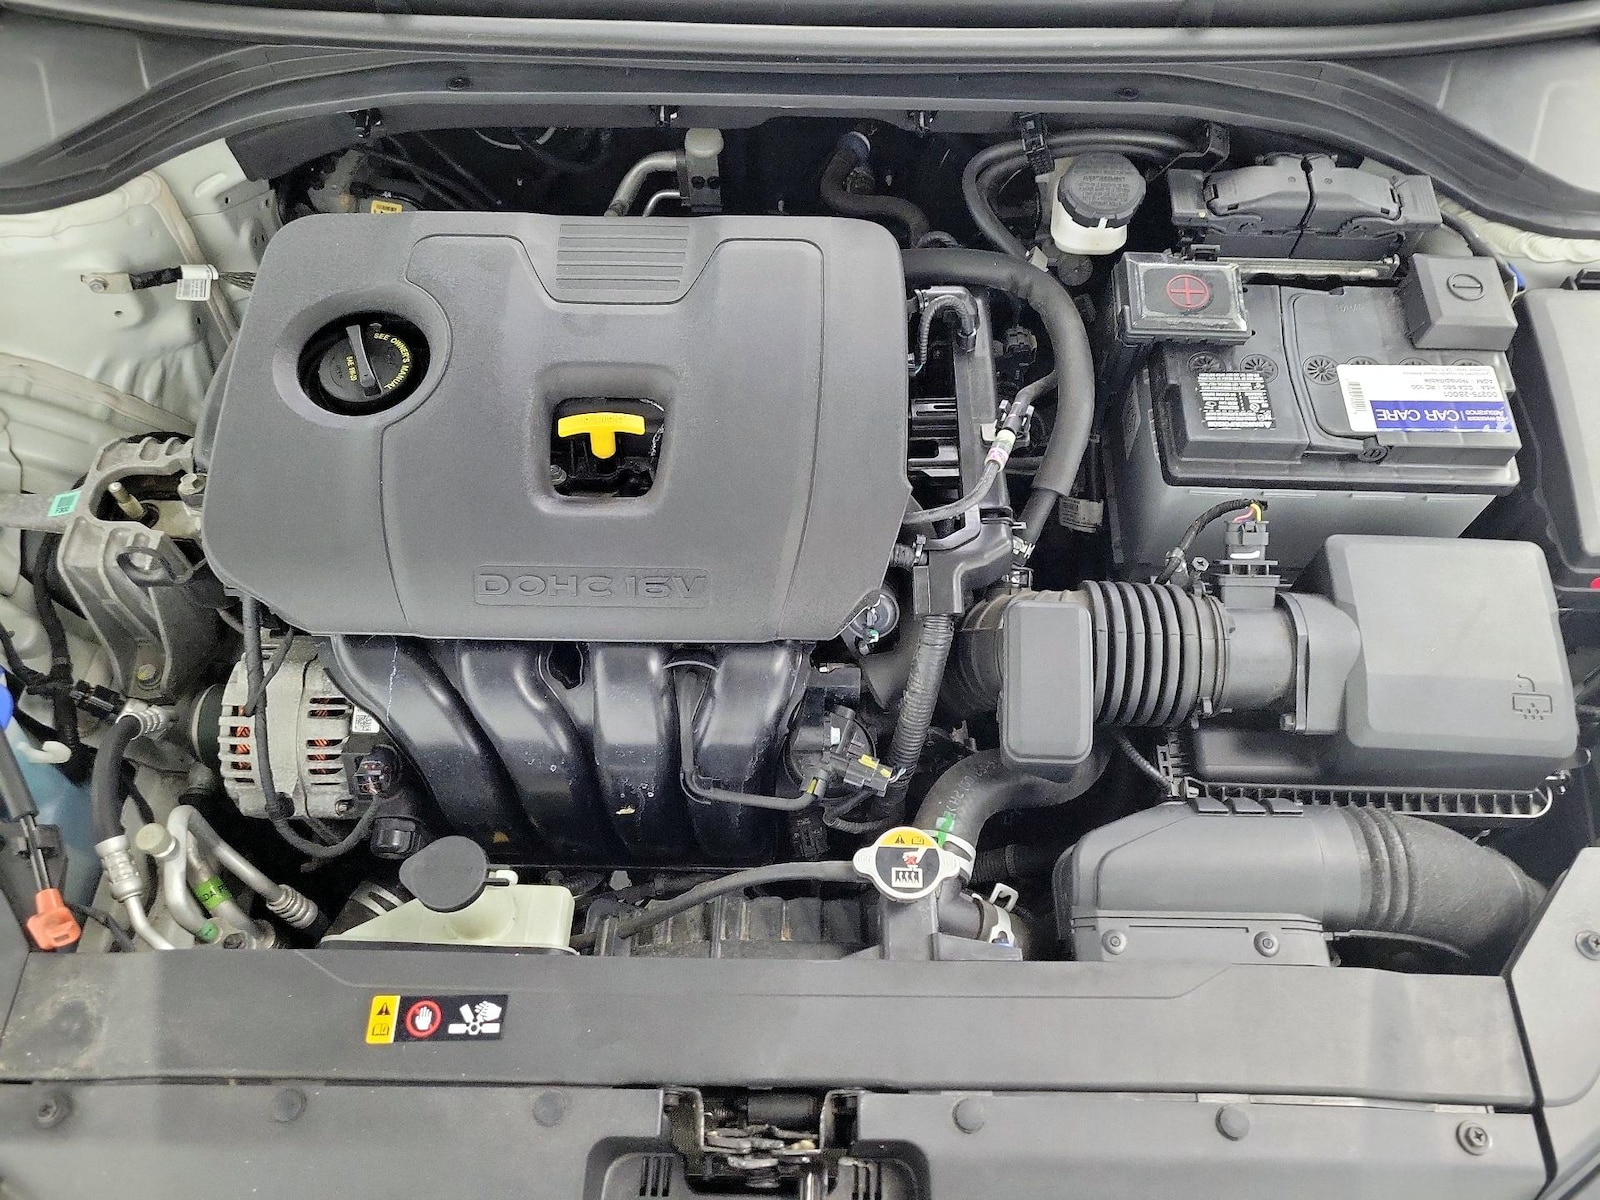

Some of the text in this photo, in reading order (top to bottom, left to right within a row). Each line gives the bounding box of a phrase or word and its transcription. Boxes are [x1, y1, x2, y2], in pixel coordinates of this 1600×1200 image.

[373, 332, 411, 390] SEE OWNER'S MANUAL
[1375, 408, 1421, 421] CARE
[1425, 408, 1461, 422] CAR
[478, 573, 707, 599] DOHC 16V
